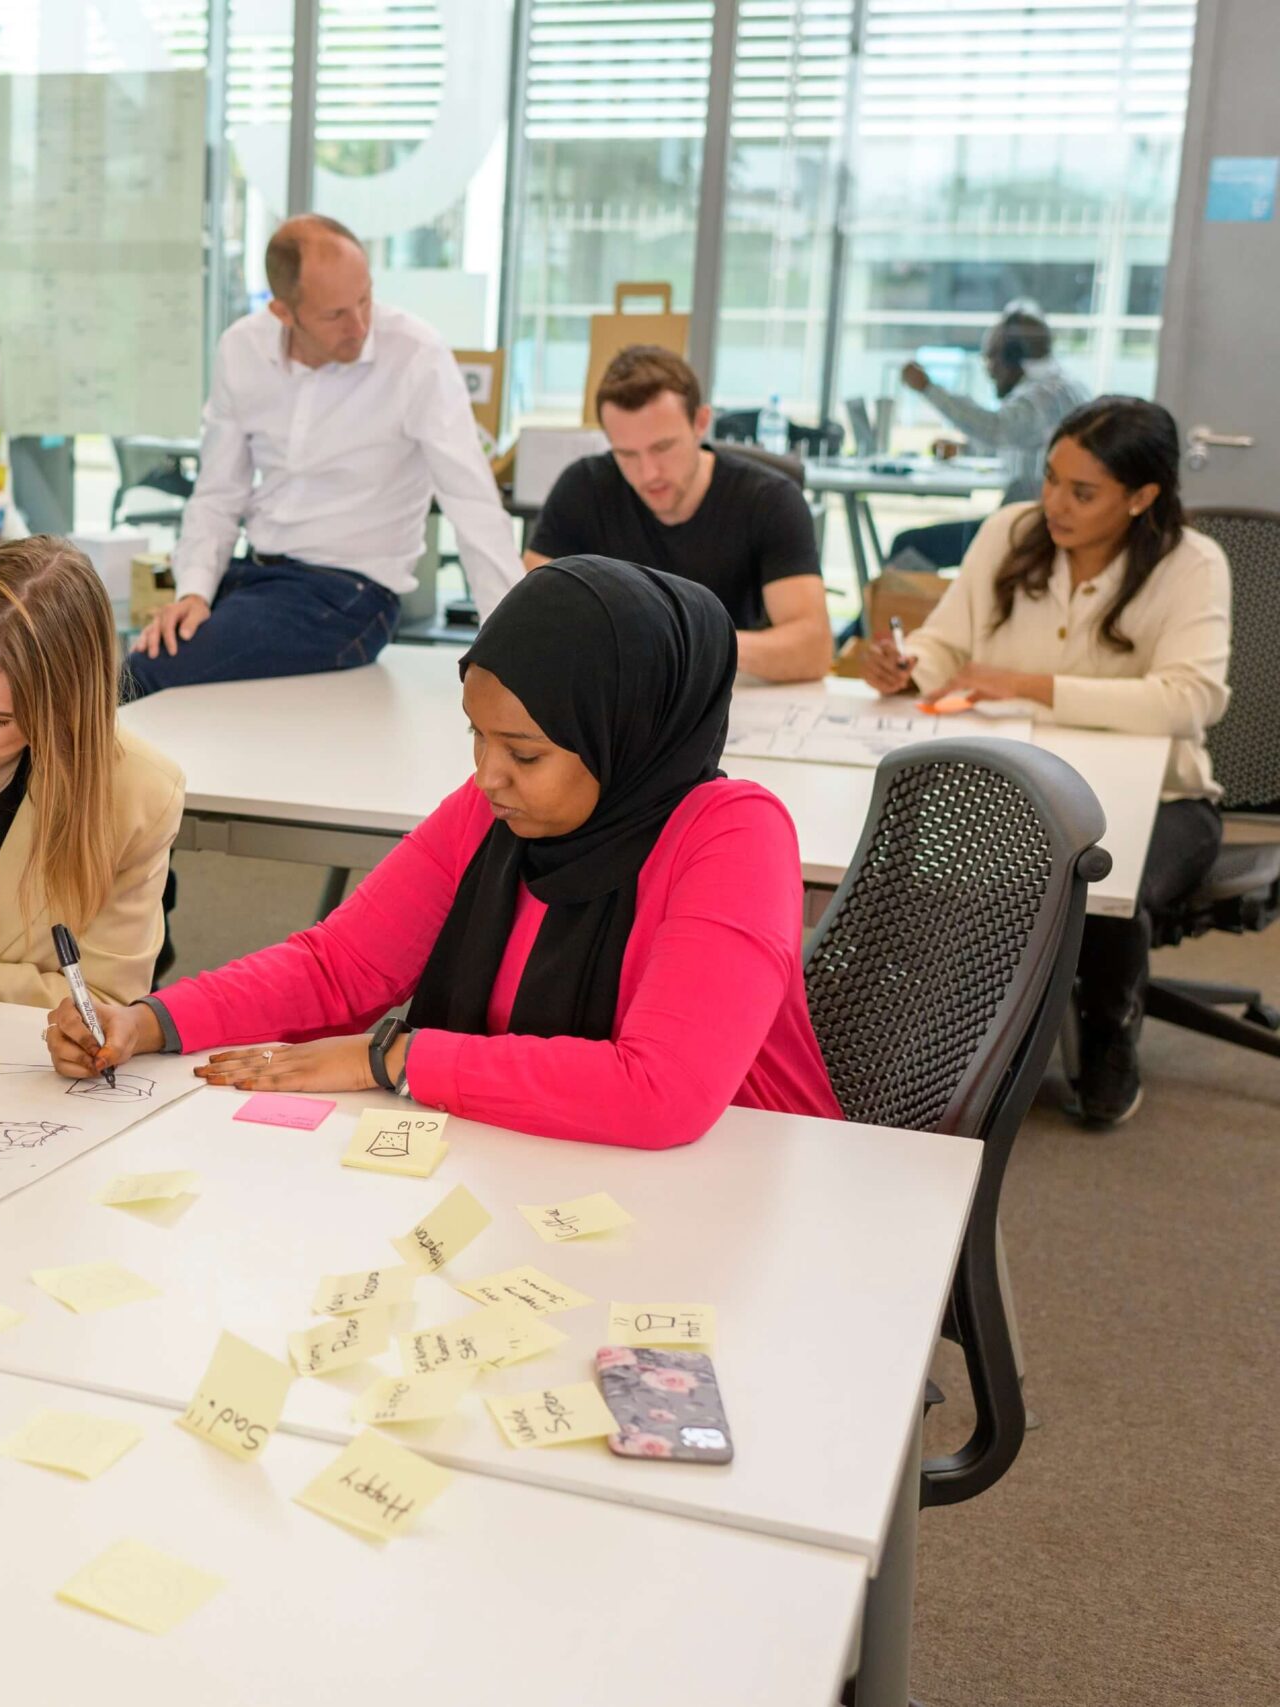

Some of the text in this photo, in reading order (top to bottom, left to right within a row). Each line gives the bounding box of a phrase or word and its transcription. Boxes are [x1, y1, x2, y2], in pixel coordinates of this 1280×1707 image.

[397, 1120, 439, 1132] Cold
[535, 1391, 575, 1434] System
[339, 1467, 416, 1524] Happy
